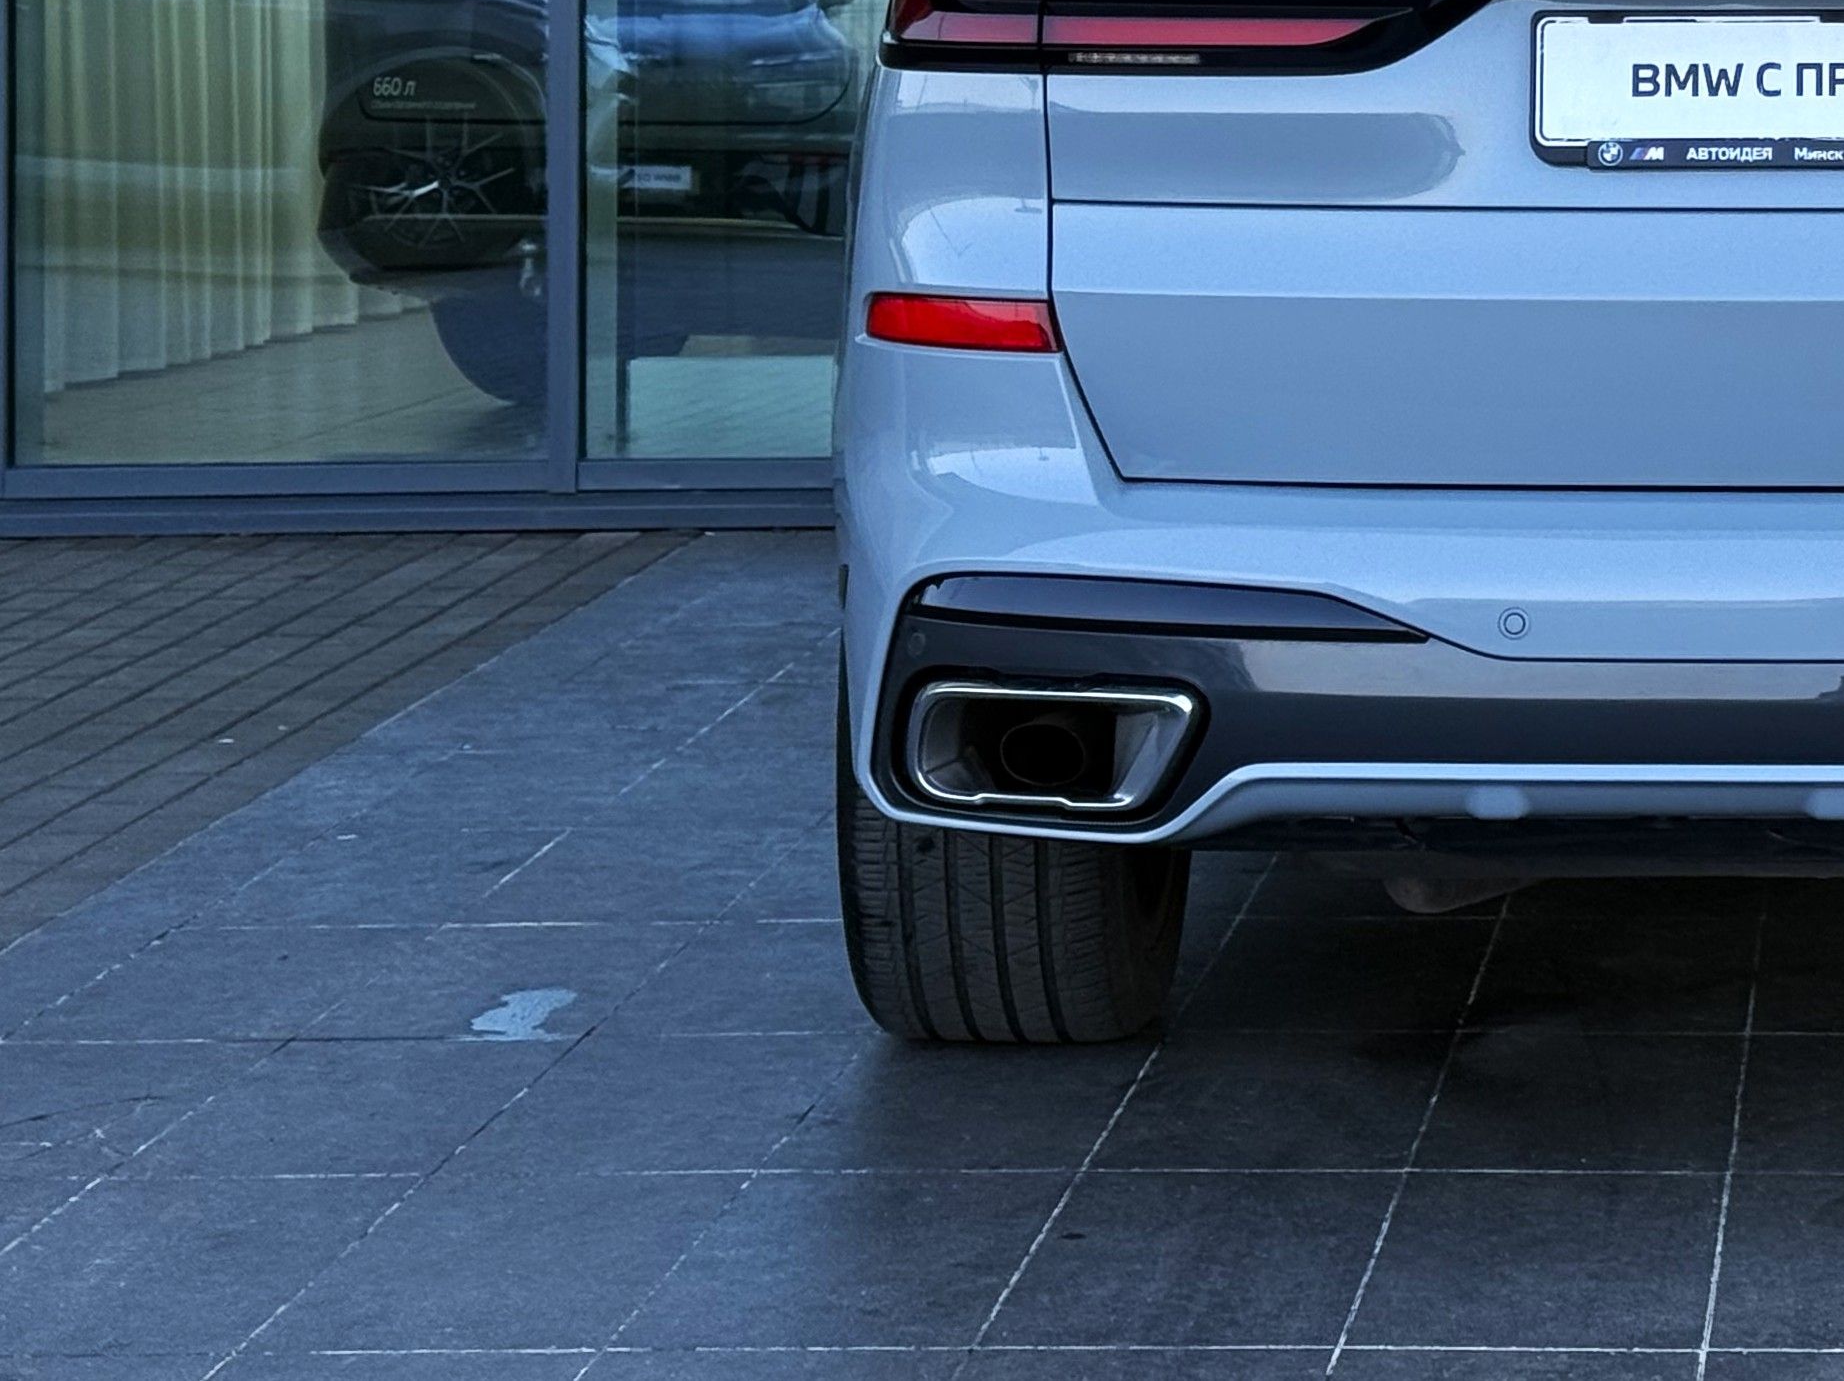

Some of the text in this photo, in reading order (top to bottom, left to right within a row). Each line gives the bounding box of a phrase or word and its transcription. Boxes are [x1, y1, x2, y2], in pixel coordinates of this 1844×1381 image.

[372, 76, 402, 97] 660
[1630, 61, 1745, 98] BMW
[1685, 146, 1773, 163] АВТОИДЕЯ
[1793, 146, 1844, 161] Минск
